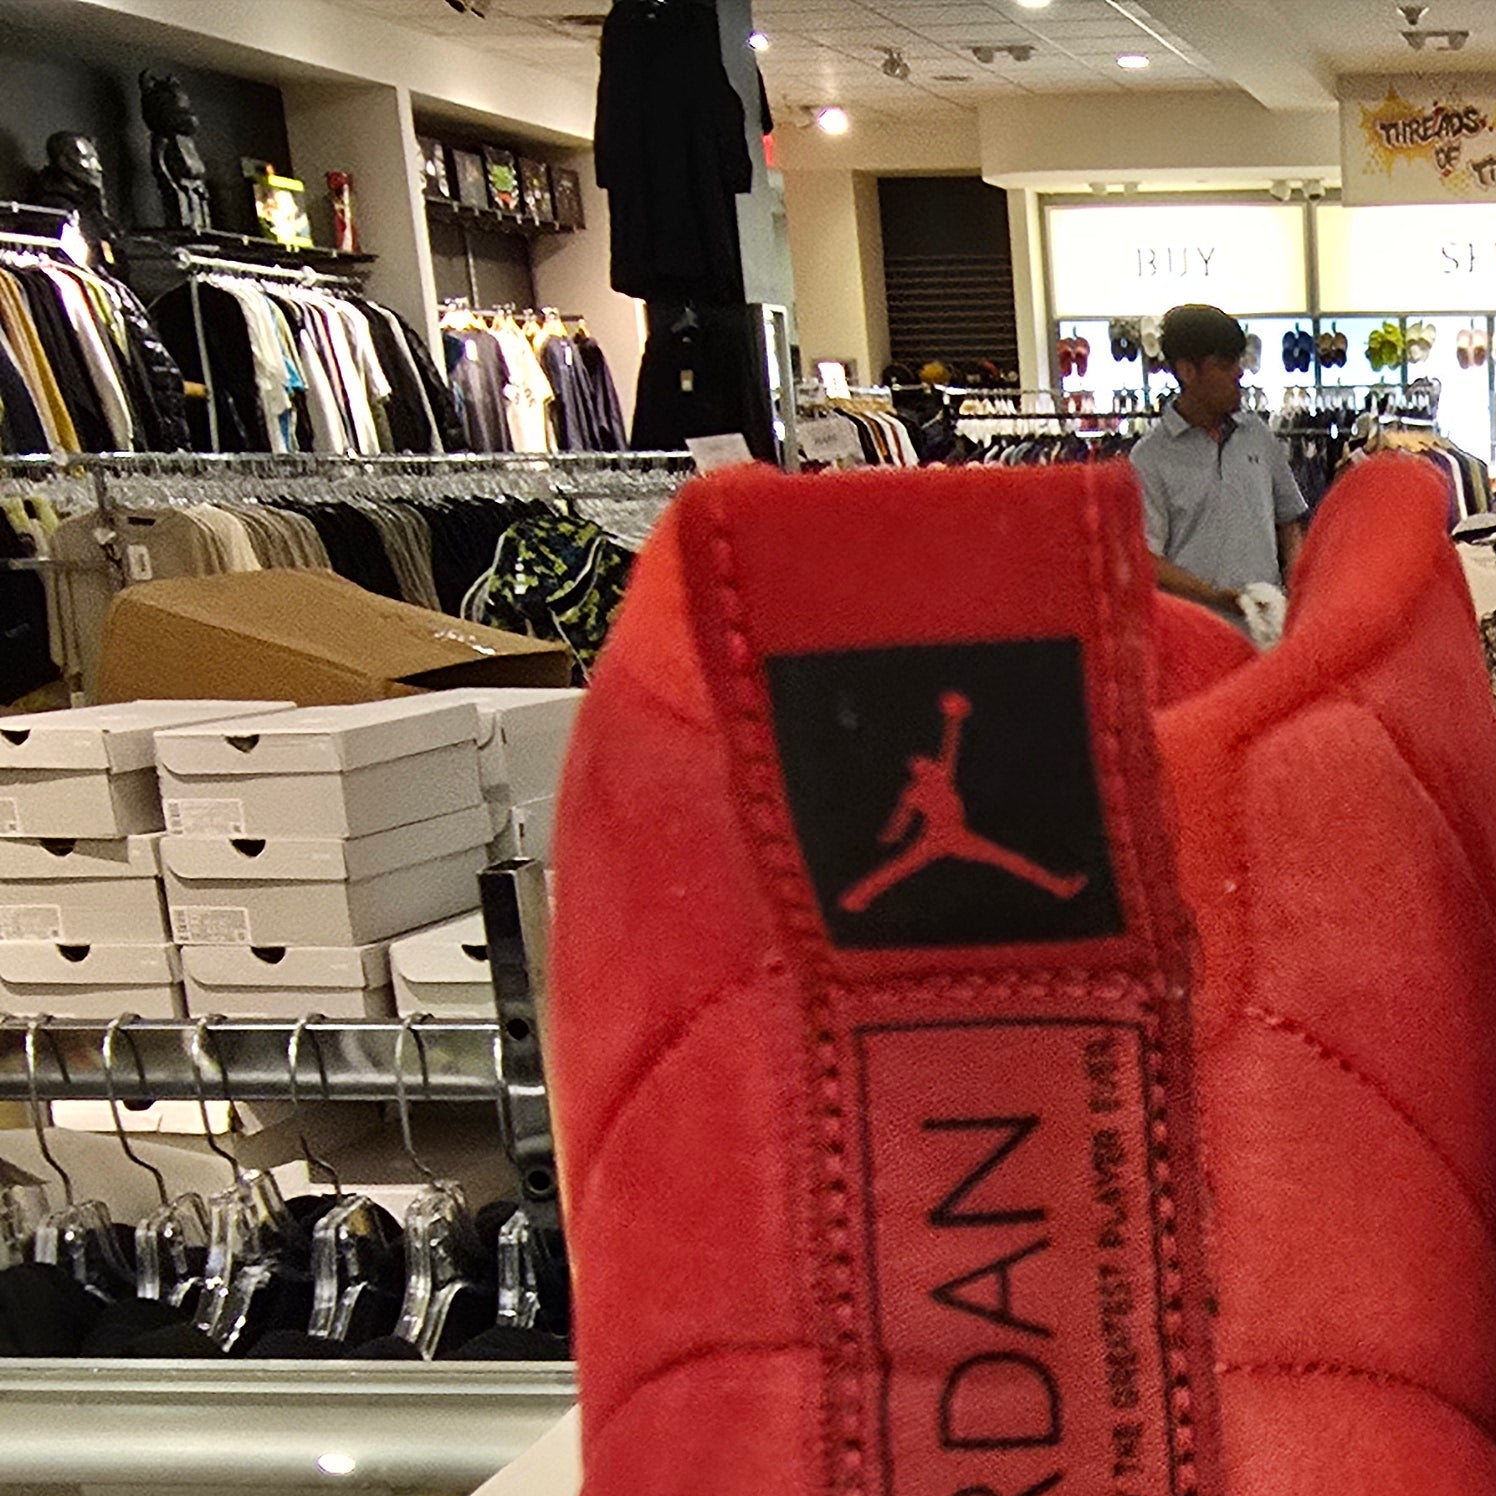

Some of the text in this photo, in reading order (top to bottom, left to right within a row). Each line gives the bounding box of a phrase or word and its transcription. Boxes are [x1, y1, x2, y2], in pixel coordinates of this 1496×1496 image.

[1377, 104, 1482, 147] THREADS
[1434, 145, 1460, 171] OF
[1136, 246, 1216, 278] BUY
[1084, 1038, 1121, 1115] EVER
[1091, 1128, 1128, 1250] PLAYER
[1098, 1264, 1140, 1410] GREATEST
[1112, 1422, 1144, 1477] THE
